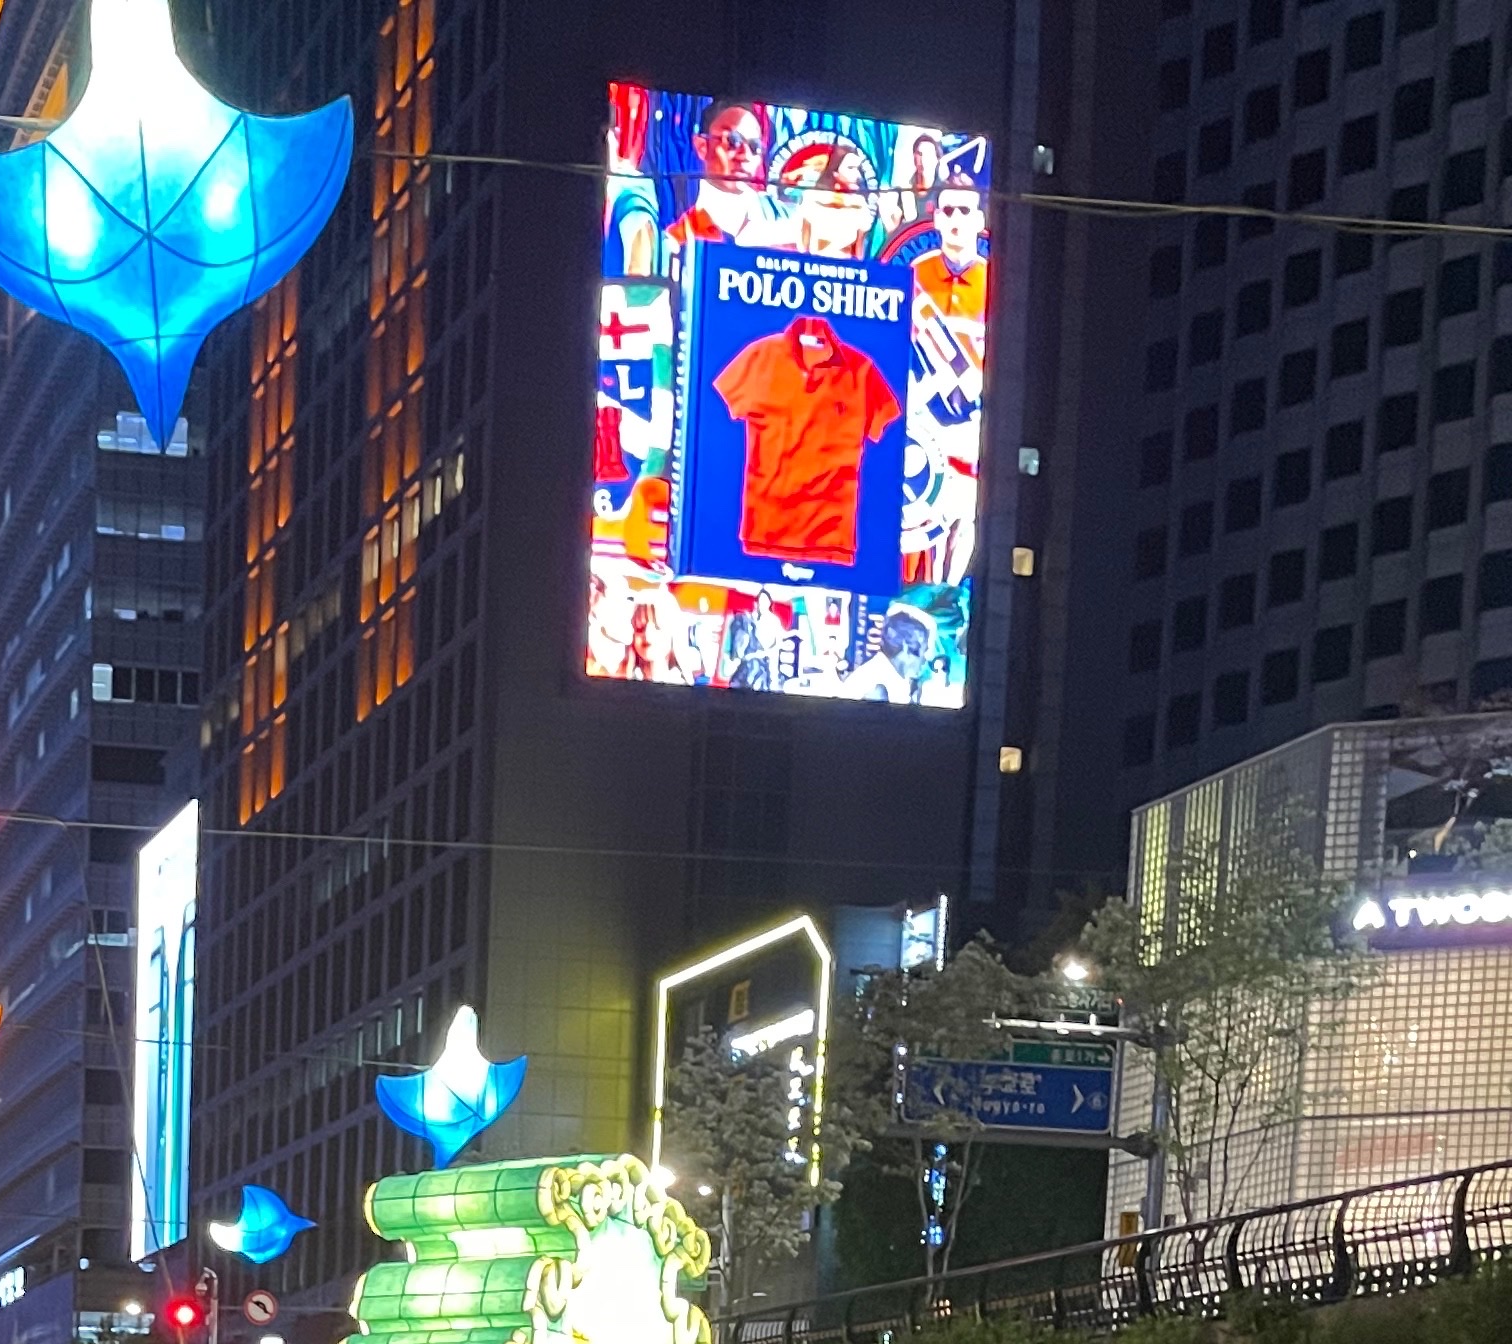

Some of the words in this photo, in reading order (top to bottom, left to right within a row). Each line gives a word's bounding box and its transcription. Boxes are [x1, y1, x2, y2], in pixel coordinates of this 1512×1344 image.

[718, 267, 806, 310] POLO
[812, 280, 905, 322] SHIRT
[1353, 900, 1386, 930] A
